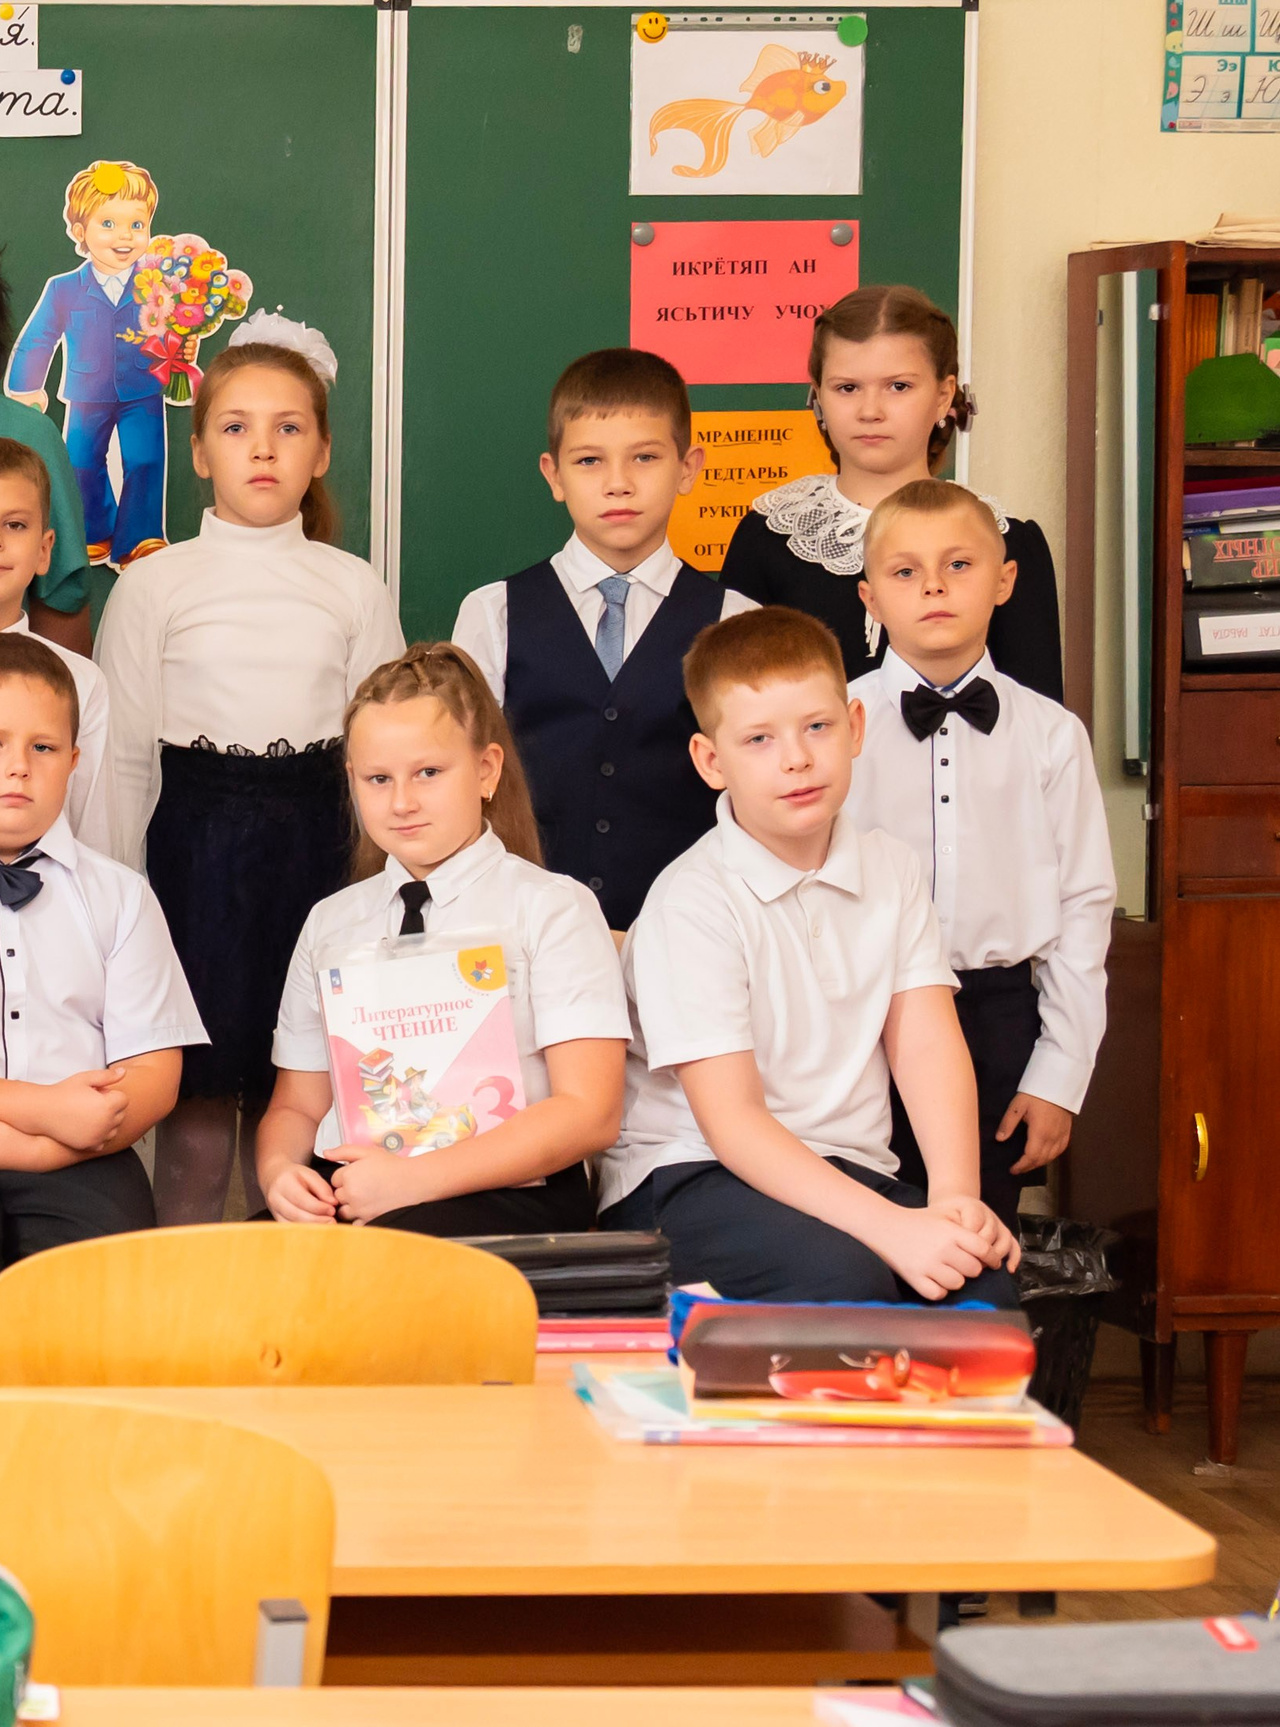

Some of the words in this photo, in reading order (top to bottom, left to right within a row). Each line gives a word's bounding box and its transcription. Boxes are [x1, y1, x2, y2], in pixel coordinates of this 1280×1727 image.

[672, 257, 768, 276] ИКРЁТЯП
[788, 258, 817, 274] АН
[656, 305, 755, 322] ЯСЬТИЧУ
[697, 428, 793, 444] МРАНЕНЦС
[702, 466, 789, 482] ТЕДТАРЬБ
[351, 997, 474, 1025] Литературное
[372, 1016, 459, 1042] ЧТЕНИЕ
